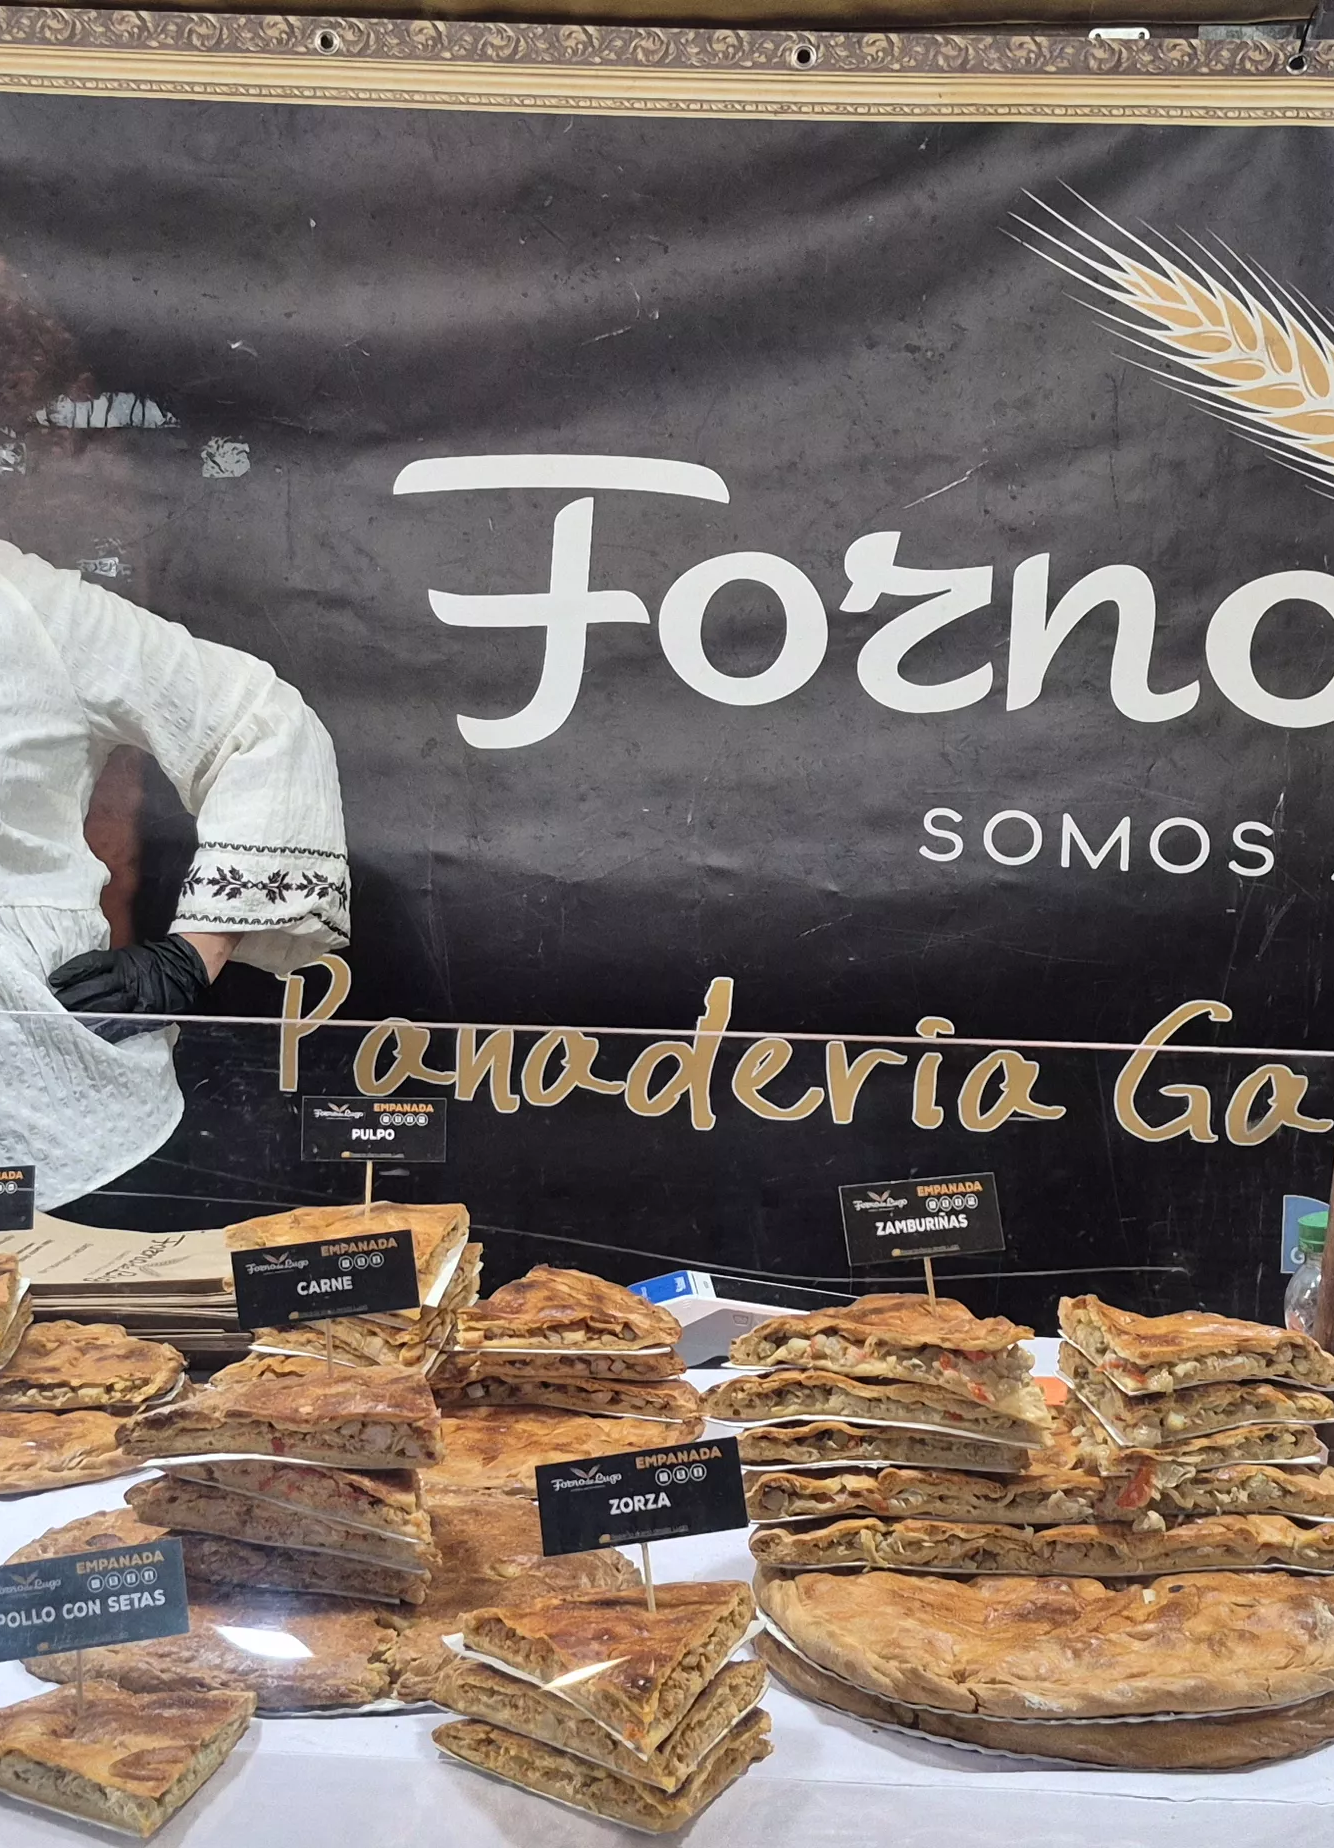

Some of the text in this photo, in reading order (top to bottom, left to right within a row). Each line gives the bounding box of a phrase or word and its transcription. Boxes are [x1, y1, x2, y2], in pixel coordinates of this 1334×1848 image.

[919, 807, 1275, 877] SOMOS
[373, 1102, 434, 1113] EMPANADA
[351, 1128, 395, 1141] PULPO
[916, 1180, 983, 1197] EMPANADA
[875, 1212, 969, 1236] ZAMBURIÑAS
[320, 1237, 398, 1257] EMPANADA
[296, 1275, 354, 1296] CARNE
[634, 1445, 723, 1471] EMPANADA
[608, 1491, 672, 1516] ZORZA
[75, 1550, 166, 1575] EMPANADA
[62, 1599, 102, 1620] CON
[107, 1589, 167, 1613] SETAS
